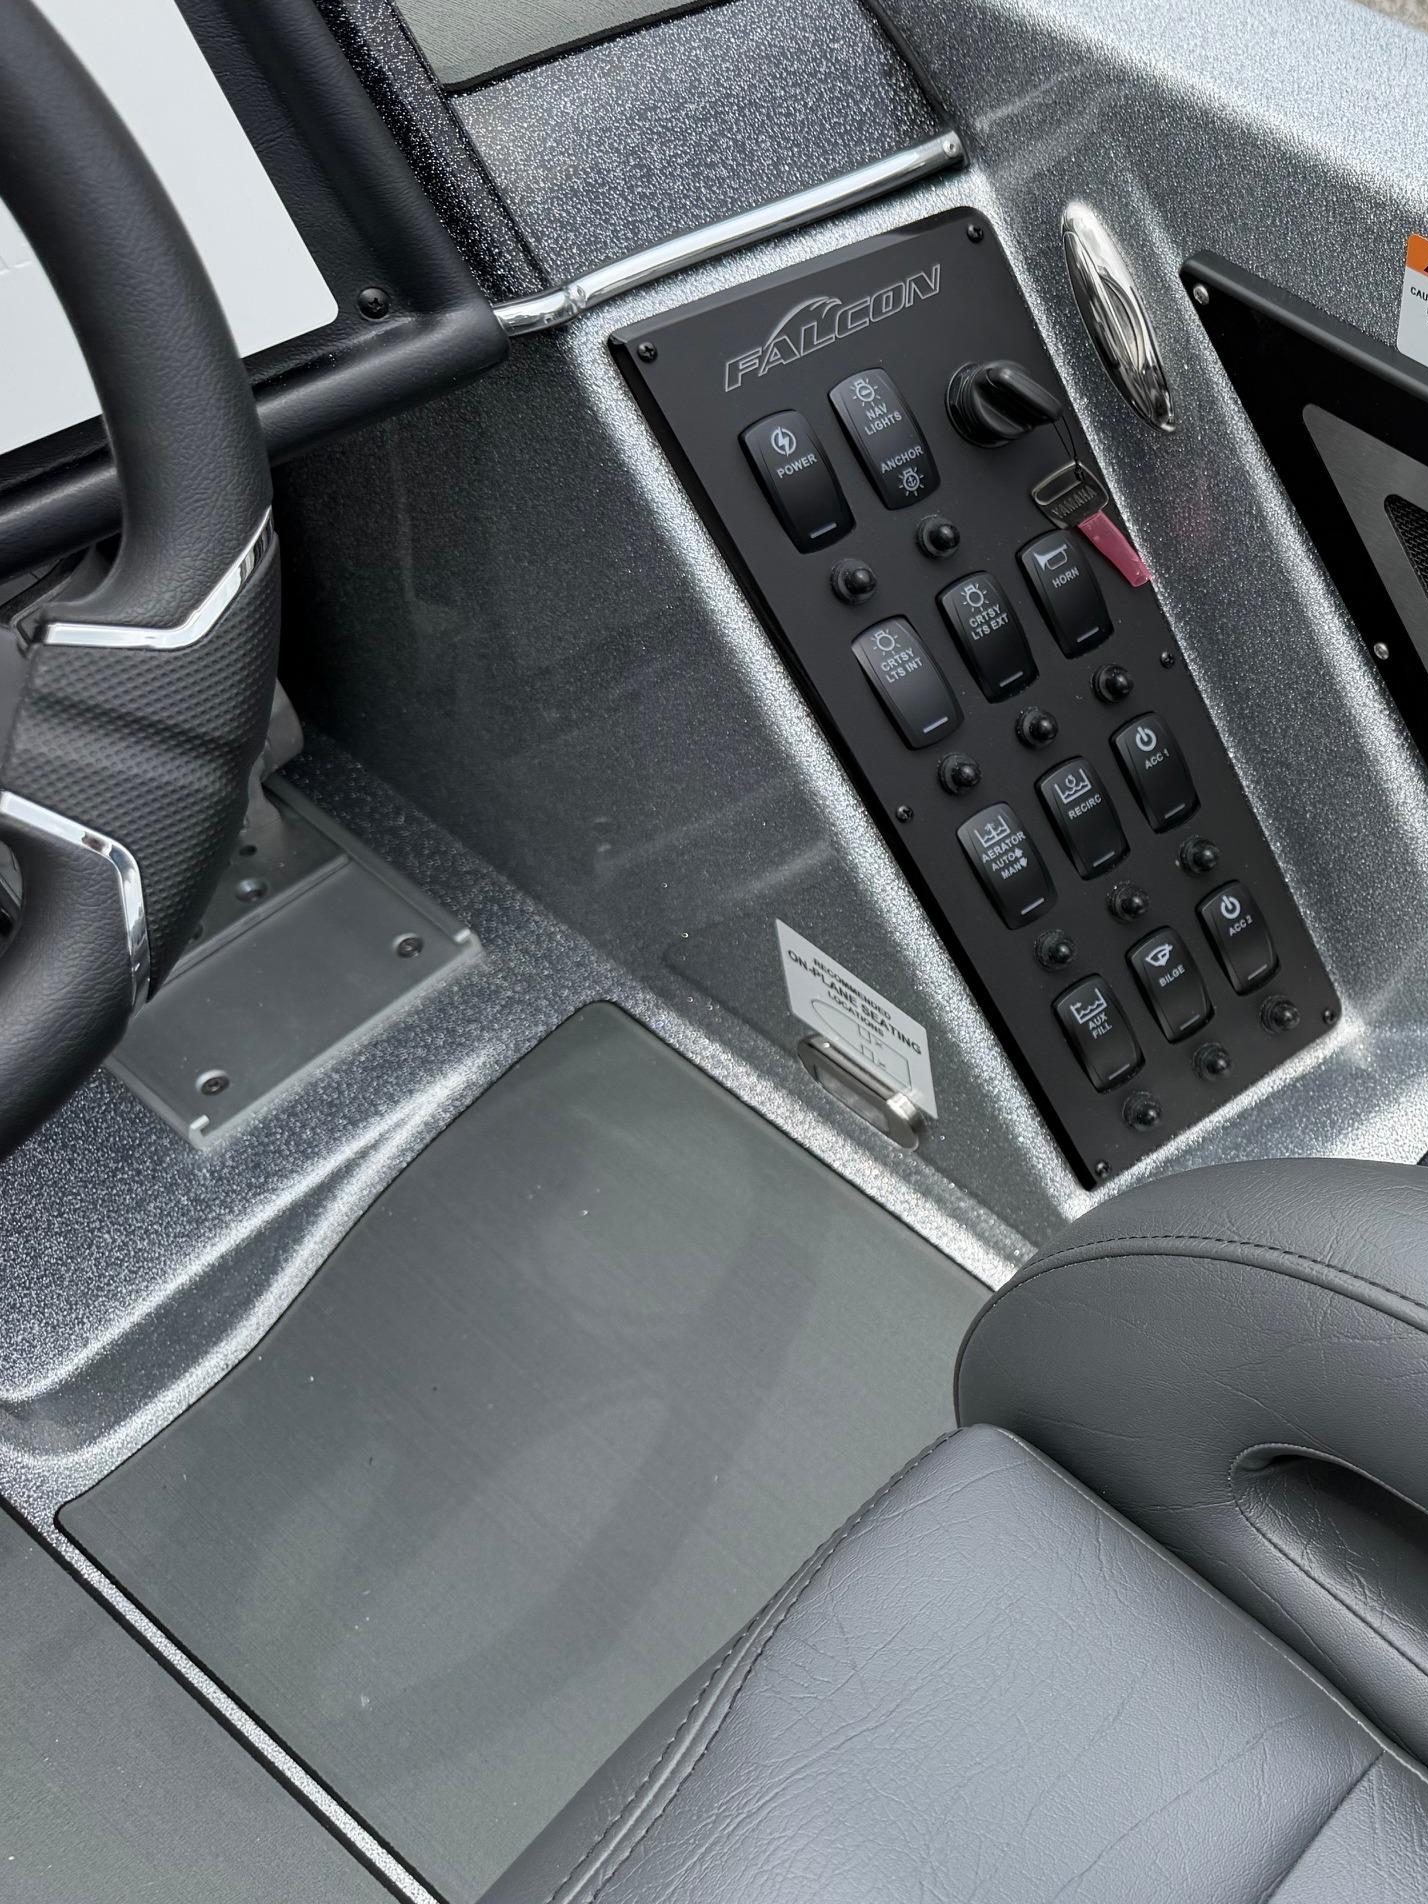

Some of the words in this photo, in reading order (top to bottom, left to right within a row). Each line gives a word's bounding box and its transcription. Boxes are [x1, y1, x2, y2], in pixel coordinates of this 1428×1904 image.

[725, 264, 940, 392] FALCON
[865, 411, 902, 435] LIGHTS
[866, 403, 888, 421] NAV
[777, 453, 817, 478] POWER
[881, 446, 923, 473] ANCHOR
[1051, 485, 1097, 518] YAMAHA
[1052, 567, 1079, 588] HORN
[969, 604, 1001, 628] CRTSY
[971, 624, 990, 640] LTS
[991, 613, 1009, 631] EXT
[881, 648, 914, 672] CRTSY
[885, 667, 906, 683] LTS
[906, 657, 924, 673] INT
[1145, 753, 1162, 770] ACC
[1163, 749, 1170, 758] 1
[1068, 794, 1102, 820] RECIRC
[981, 831, 1027, 863] AERATOR
[992, 853, 1016, 872] AUTO
[1001, 863, 1021, 880] MAN
[1229, 919, 1246, 936] ACC
[1246, 915, 1253, 924] 2
[1159, 964, 1185, 987] BILGE
[787, 947, 857, 1008] ON-PLANE
[861, 1002, 921, 1056] SEATING
[827, 989, 883, 1037] LOCATIONS
[1089, 1012, 1108, 1030] AUX
[1092, 1023, 1113, 1039] FILL
